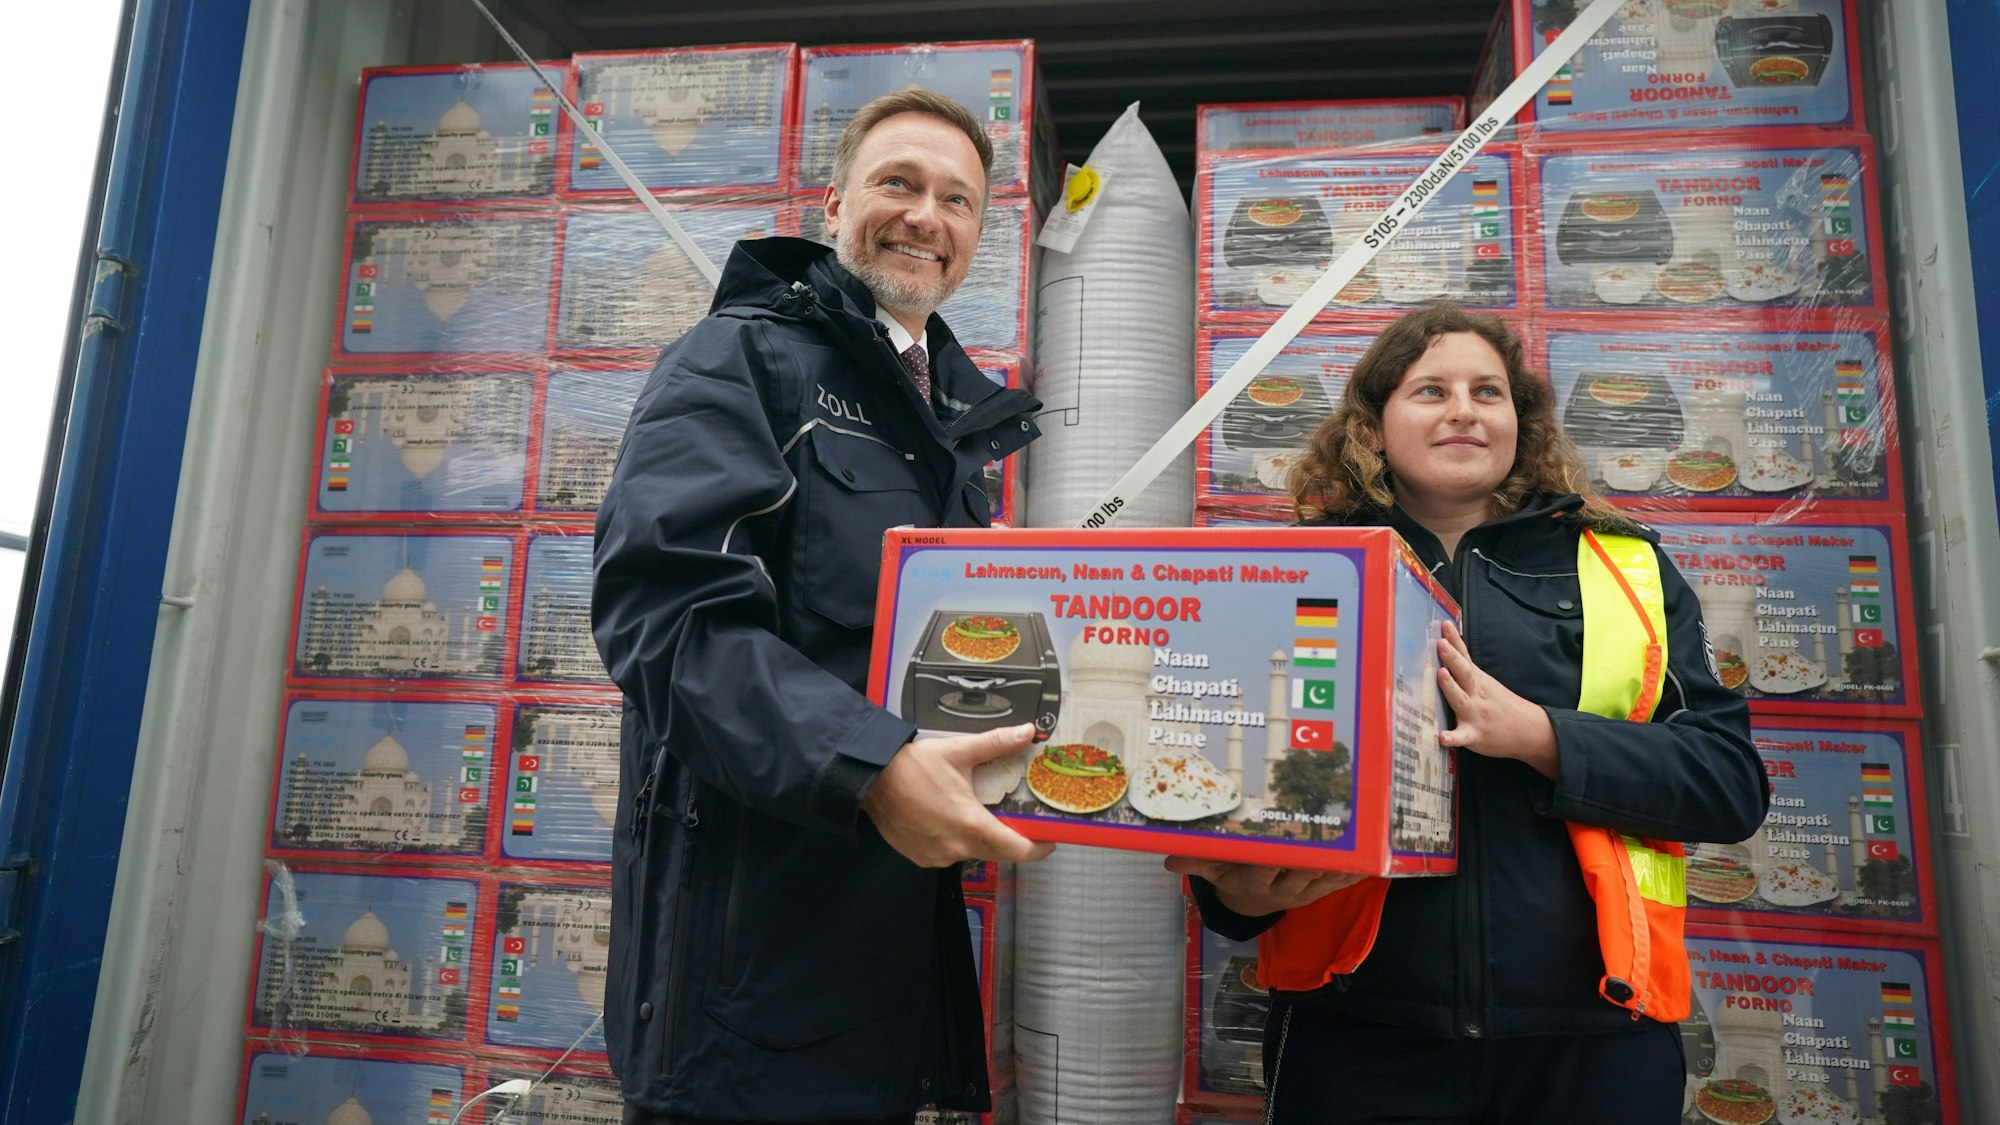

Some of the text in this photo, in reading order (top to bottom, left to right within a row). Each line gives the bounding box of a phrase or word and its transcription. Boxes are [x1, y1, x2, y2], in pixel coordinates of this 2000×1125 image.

[1618, 23, 1656, 35] Pane
[1601, 48, 1657, 63] Chapati
[1621, 64, 1658, 76] Naan
[1658, 72, 1707, 86] FORNO
[1629, 86, 1733, 104] TANDOOR
[1297, 129, 1376, 143] TANDOOR
[1364, 216, 1399, 250] S105
[1403, 132, 1482, 210] 2300daN/5100
[1478, 115, 1500, 137] lbs
[1656, 175, 1762, 192] TANDOOR
[1682, 194, 1743, 206] FORNO
[1733, 205, 1770, 218] Naan
[1734, 220, 1793, 233] Chapati
[1736, 249, 1775, 261] Pane
[1667, 360, 1775, 376] TANDOOR
[1693, 379, 1756, 391] FORNO
[816, 383, 873, 426] ZOLL
[1745, 391, 1784, 404] Naan
[1745, 407, 1806, 421] Chapati
[1747, 421, 1825, 436] Lahmacun
[1747, 436, 1788, 450] Pane
[1081, 496, 1125, 529] 00 lbs
[901, 537, 947, 545] XL MODEL
[1688, 533, 1730, 546] Naan
[1732, 534, 1743, 546] &
[1746, 534, 1804, 548] Chapati
[1808, 535, 1855, 548] Maker
[1674, 553, 1786, 572] TANDOOR
[965, 562, 1309, 586] Lahmacun, Naan & Chapati Maker
[1702, 574, 1767, 587] FORNO
[1755, 587, 1796, 600] Naan
[1050, 594, 1202, 622] TANDOOR
[1756, 604, 1818, 619] Chapati
[1757, 620, 1838, 635] Lahmacun
[1083, 626, 1170, 647] FORNO
[1758, 636, 1800, 649] Pane
[1153, 648, 1209, 669] Naan
[1151, 674, 1239, 700] Chapati
[1149, 700, 1266, 727] Lahmacun
[1148, 726, 1207, 748] Pane
[1755, 737, 1868, 754] Chapati Maker
[1768, 795, 1806, 808] Naan
[1251, 809, 1341, 827] MODEL: PK-8660
[1767, 812, 1830, 827] Chapati
[1768, 828, 1850, 846] Lahmacun
[1768, 846, 1811, 860] Pane
[1709, 949, 1750, 965] Naan
[1754, 951, 1767, 965] &
[1771, 953, 1833, 970] Chapati
[1837, 957, 1888, 973] Maker
[1695, 971, 1815, 996] TANDOOR
[1725, 996, 1793, 1013] FORNO
[1782, 1013, 1825, 1029] Naan
[1783, 1032, 1849, 1050] Chapati
[1784, 1050, 1871, 1070] Lahmacun
[1786, 1068, 1831, 1084] Pane
